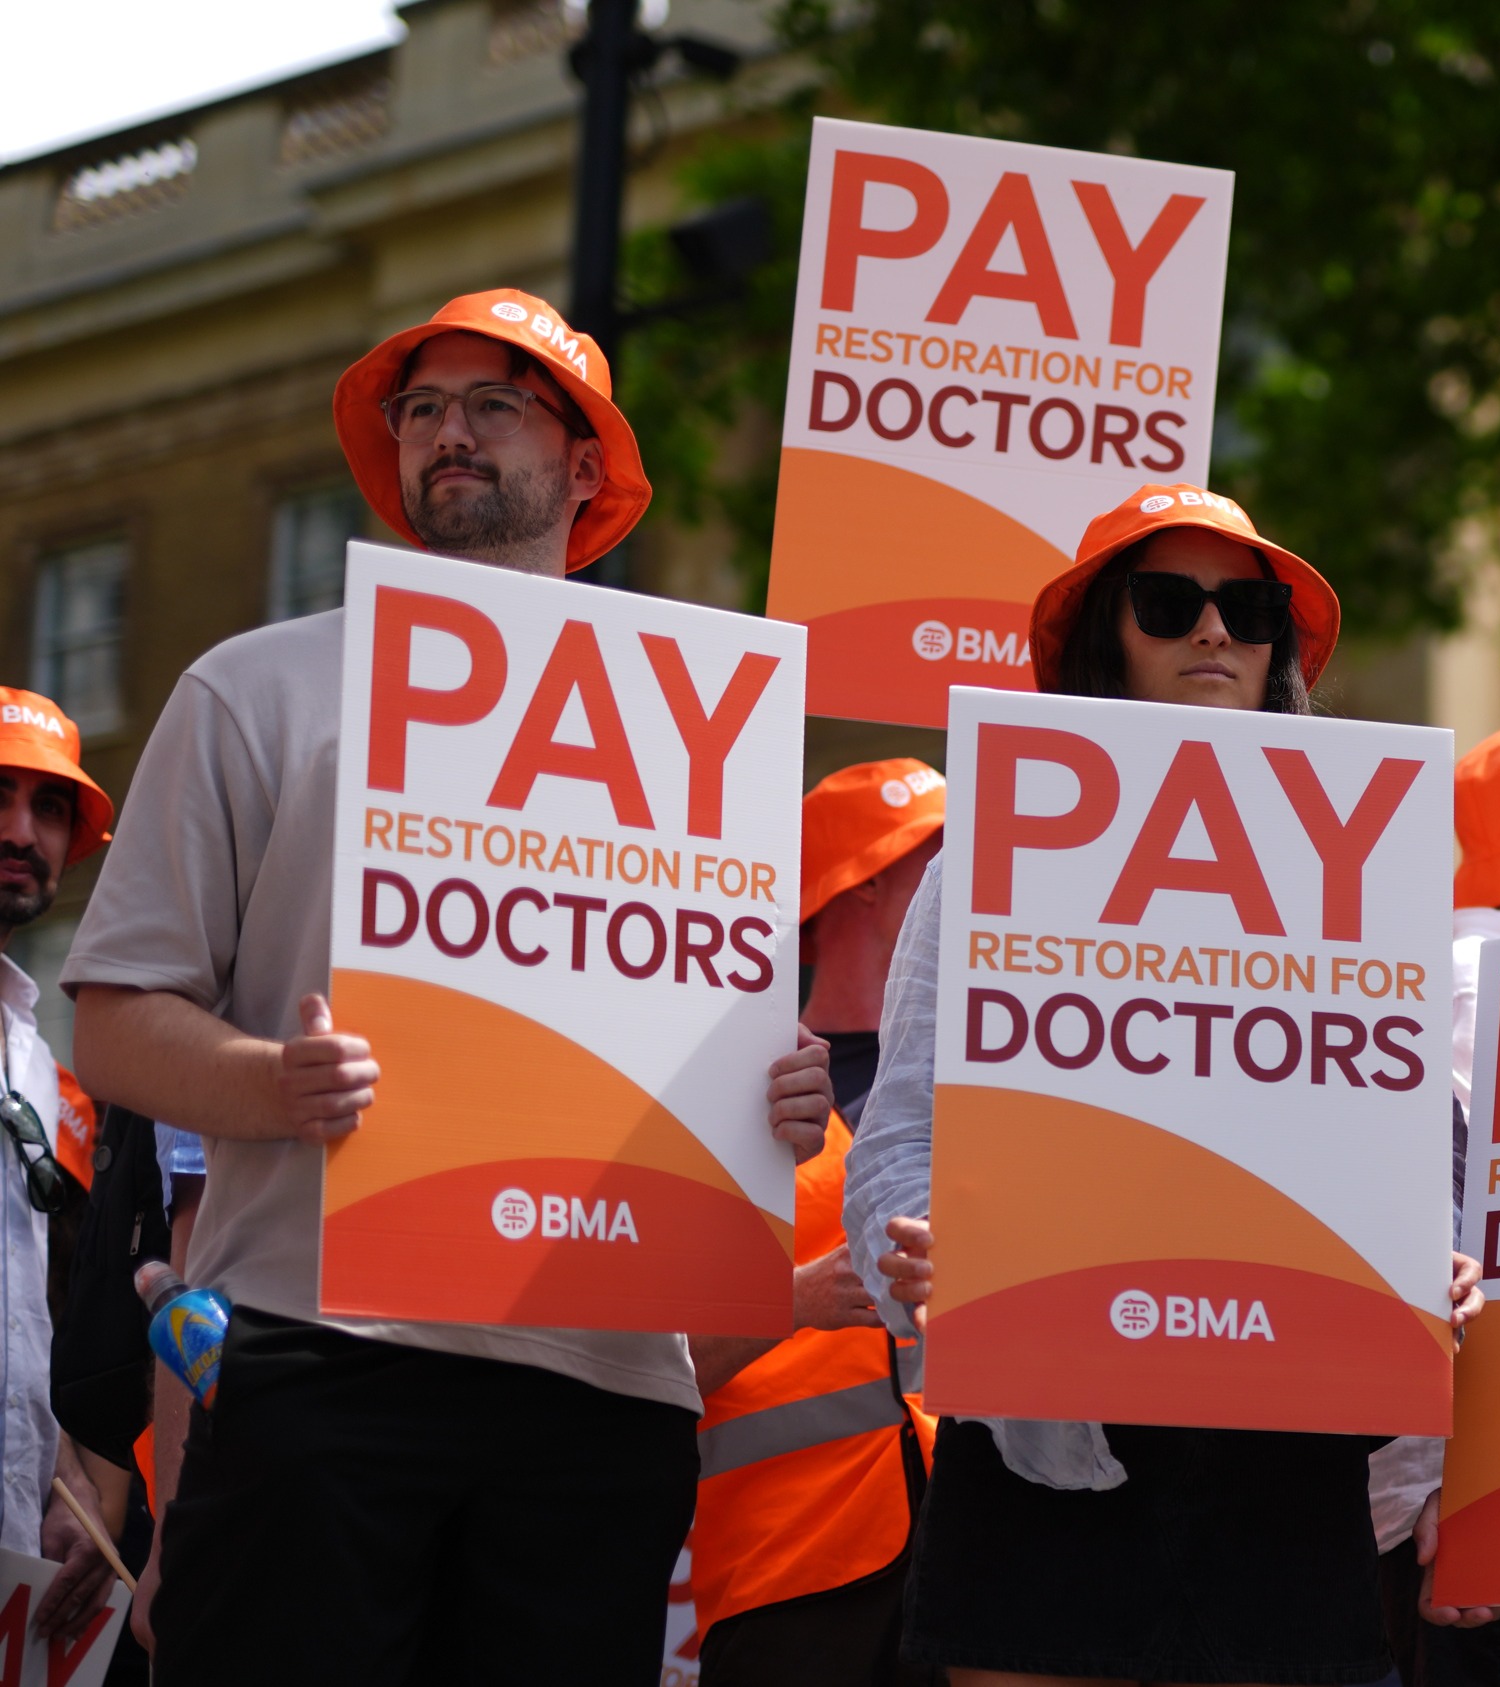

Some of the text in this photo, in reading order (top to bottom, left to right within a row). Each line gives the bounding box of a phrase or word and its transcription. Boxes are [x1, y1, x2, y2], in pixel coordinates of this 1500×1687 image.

[820, 149, 1207, 349] PAY
[531, 314, 587, 381] BMA
[815, 322, 1193, 400] RESTORATION FOR
[808, 369, 1187, 473] DOCTORS
[1178, 491, 1251, 529] BMA
[2, 704, 65, 739] BMA
[366, 584, 782, 840] PAY
[904, 767, 947, 796] BM
[364, 806, 777, 903] RESTORATION FOR
[971, 721, 1426, 943] PAY
[360, 867, 775, 994] DOCTORS
[968, 930, 1426, 1002] RESTORATION FOR
[965, 987, 1425, 1092] DOCTORS
[541, 1194, 640, 1244] BMA
[1165, 1295, 1276, 1342] BMA
